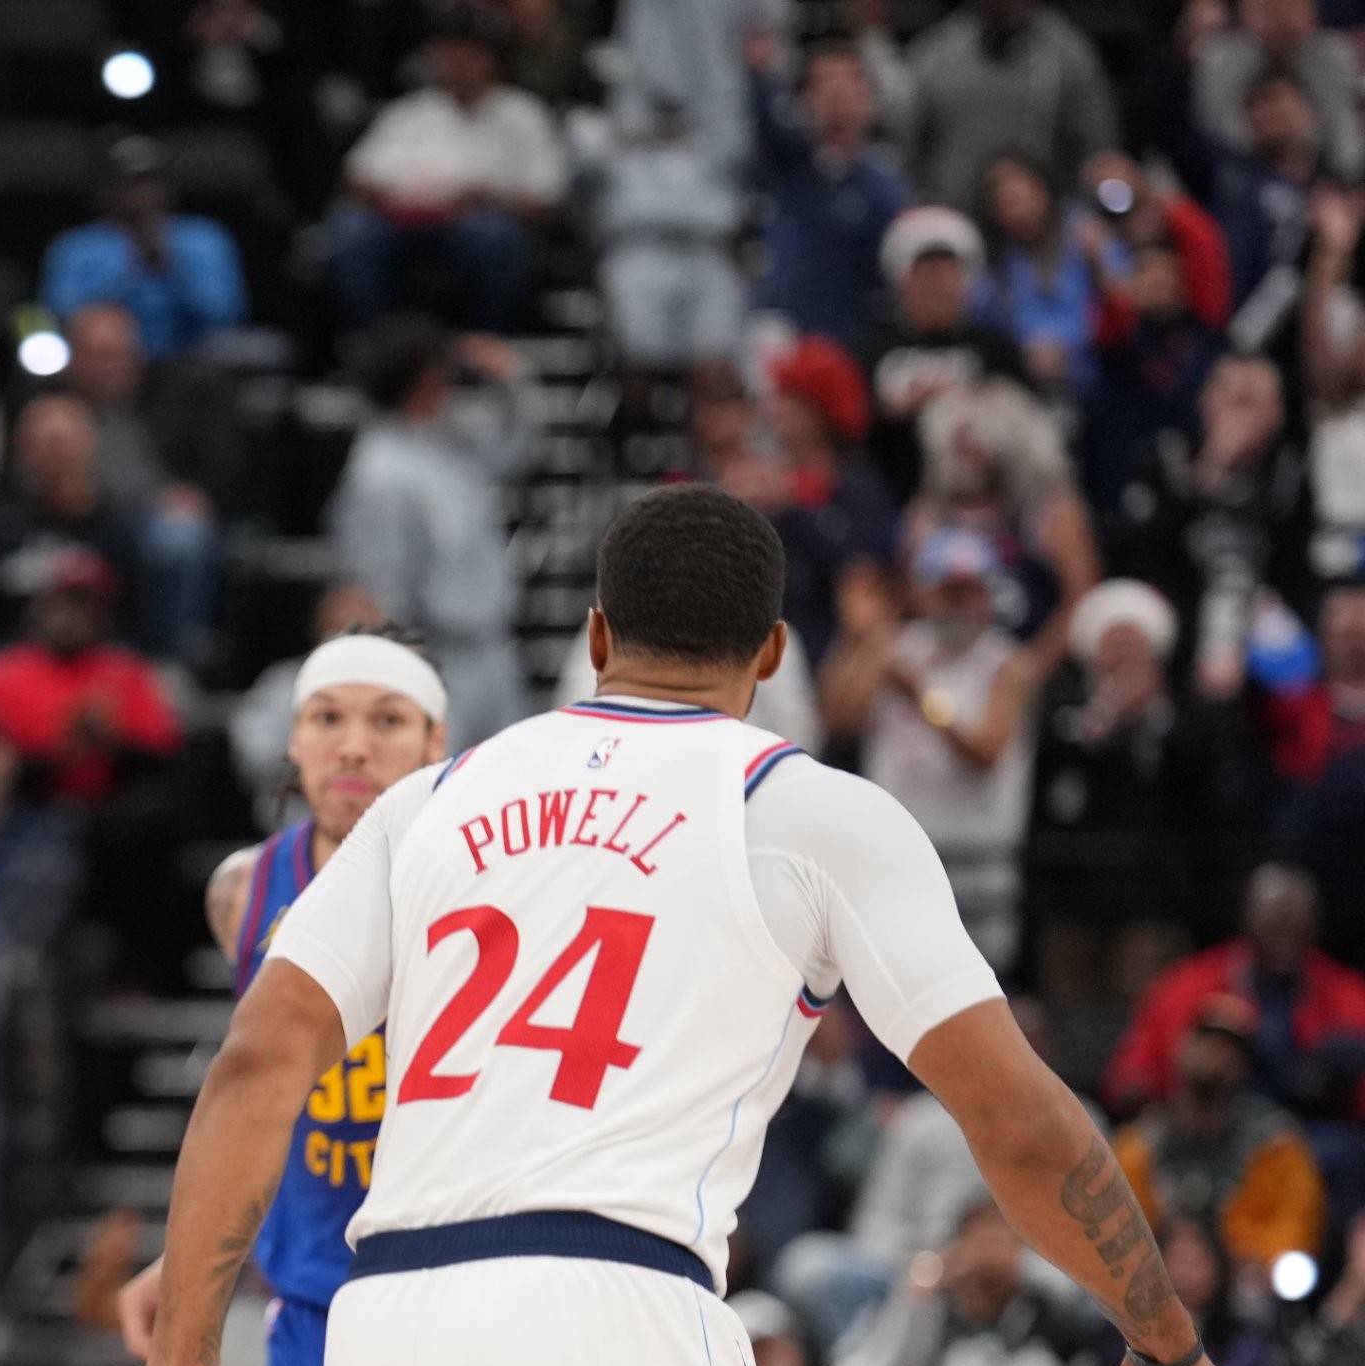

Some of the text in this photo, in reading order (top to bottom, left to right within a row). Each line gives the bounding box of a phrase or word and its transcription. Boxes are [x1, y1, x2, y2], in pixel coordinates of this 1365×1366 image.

[459, 789, 688, 877] POWELL
[397, 904, 656, 1111] 24
[304, 1129, 377, 1190] CIT
